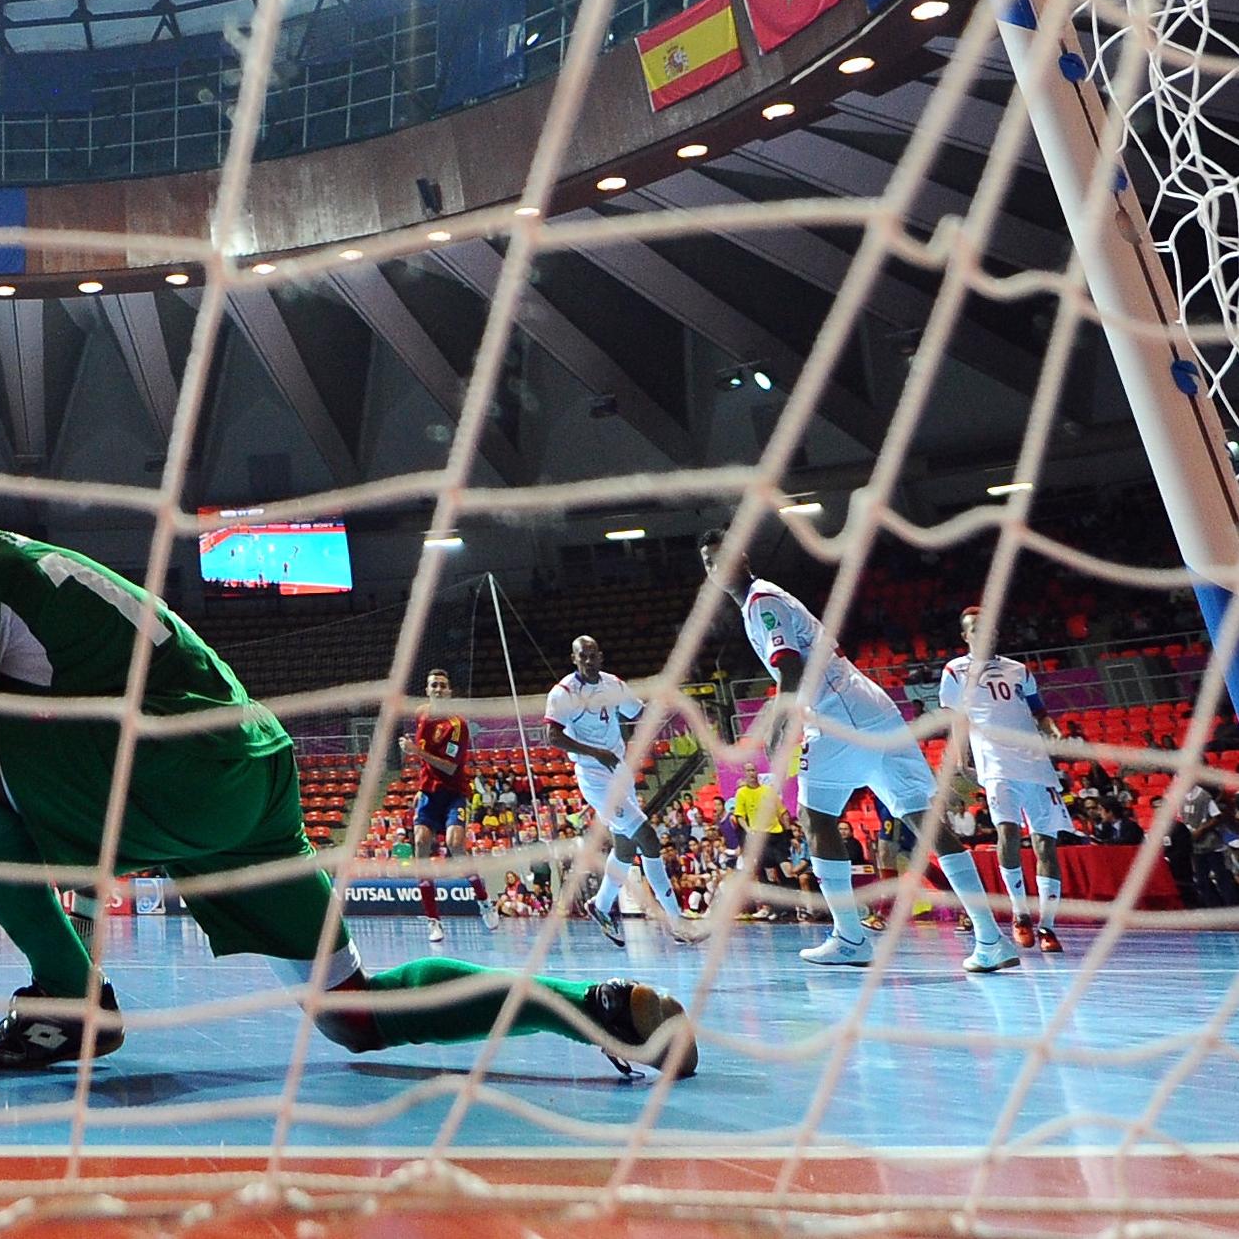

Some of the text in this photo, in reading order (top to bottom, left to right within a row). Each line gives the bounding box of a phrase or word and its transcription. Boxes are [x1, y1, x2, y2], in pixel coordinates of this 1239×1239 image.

[986, 680, 1012, 702] 10
[599, 705, 610, 725] 4
[884, 819, 894, 835] 9
[344, 887, 396, 902] FUTSAL
[396, 887, 449, 902] WOD
